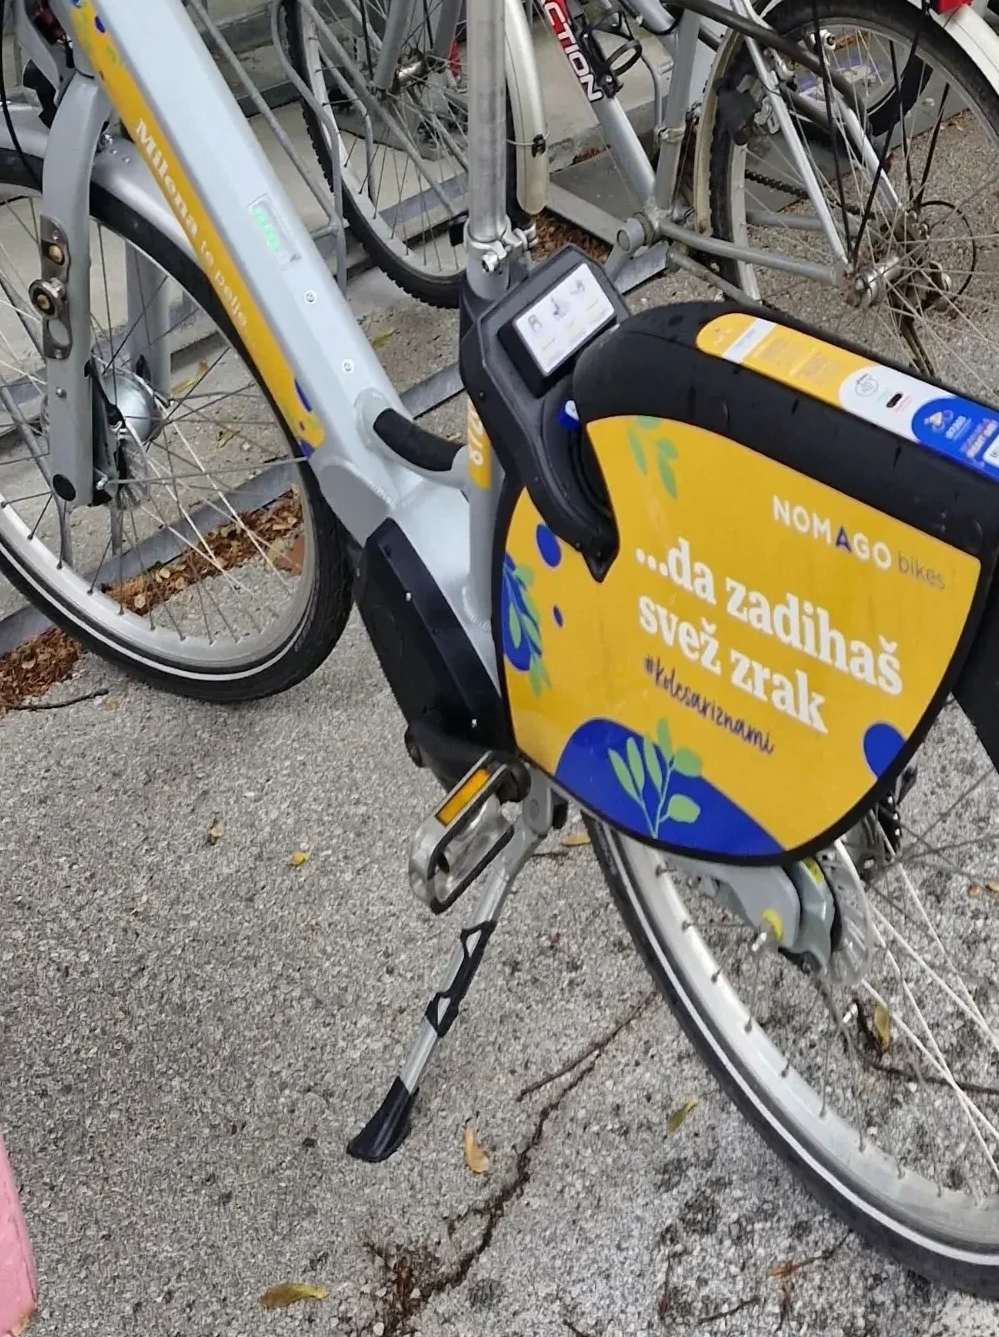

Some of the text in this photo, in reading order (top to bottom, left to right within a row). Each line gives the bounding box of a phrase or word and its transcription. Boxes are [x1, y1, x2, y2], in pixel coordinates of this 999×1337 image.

[135, 117, 199, 238] Milena
[772, 494, 946, 591] NOMAGO bikes
[635, 536, 902, 696] ...da zadihaš
[638, 594, 828, 734] svež zrak
[643, 653, 775, 756] #kolesariznami
